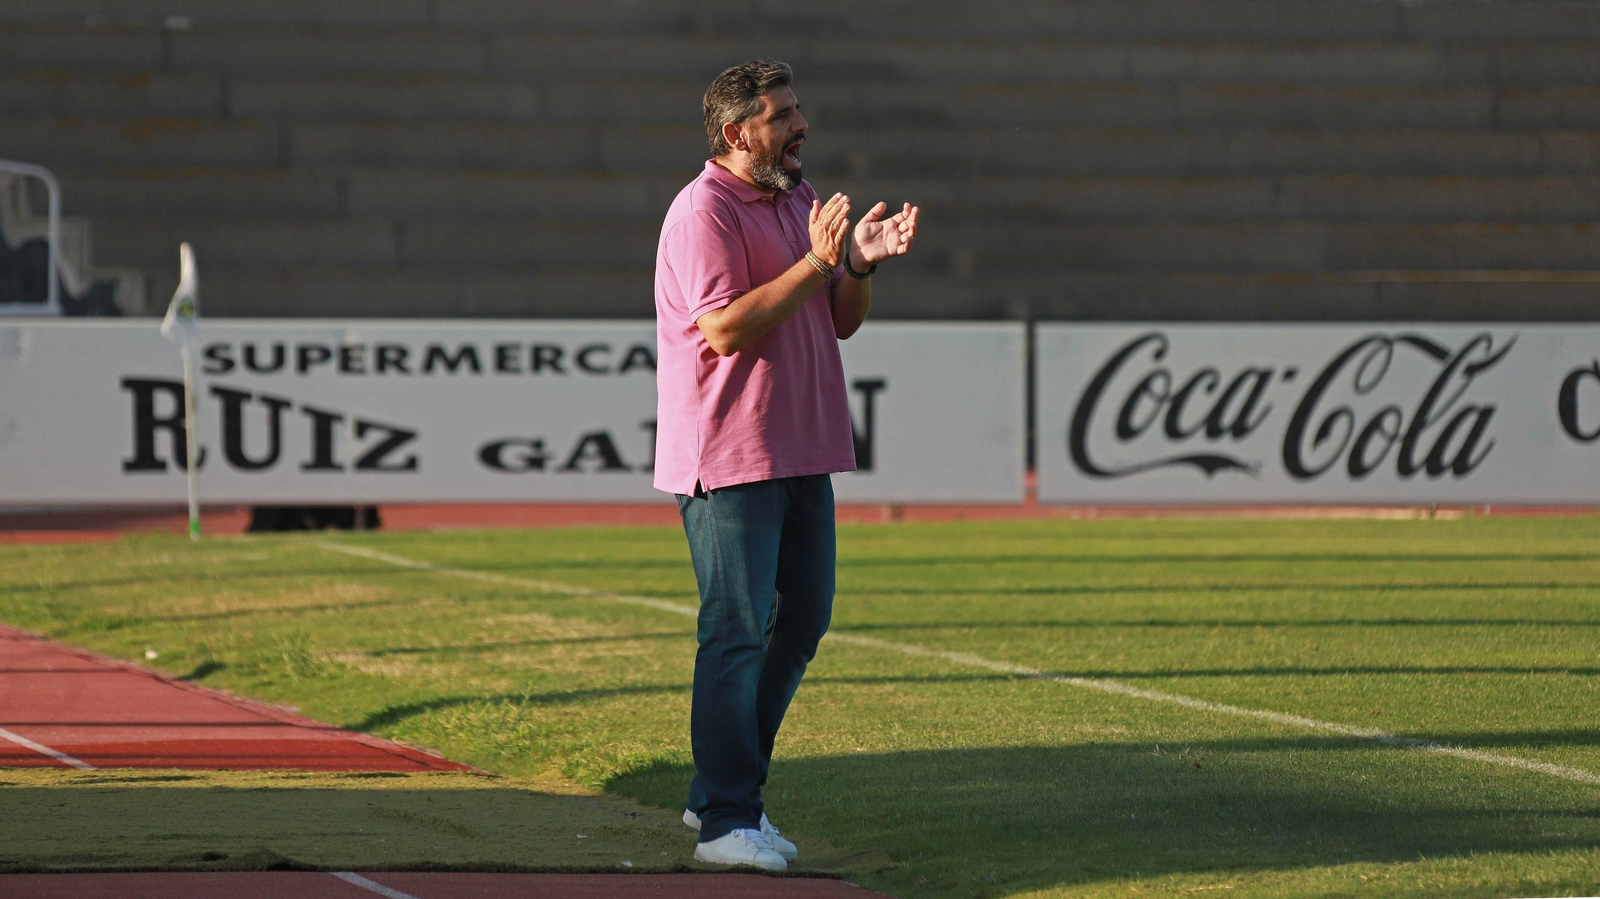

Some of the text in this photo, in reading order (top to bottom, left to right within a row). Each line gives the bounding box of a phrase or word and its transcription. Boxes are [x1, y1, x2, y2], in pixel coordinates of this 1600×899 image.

[203, 342, 657, 375] SUPERMERCA
[1069, 331, 1519, 480] Coca-Cola
[120, 376, 419, 473] RUIZ
